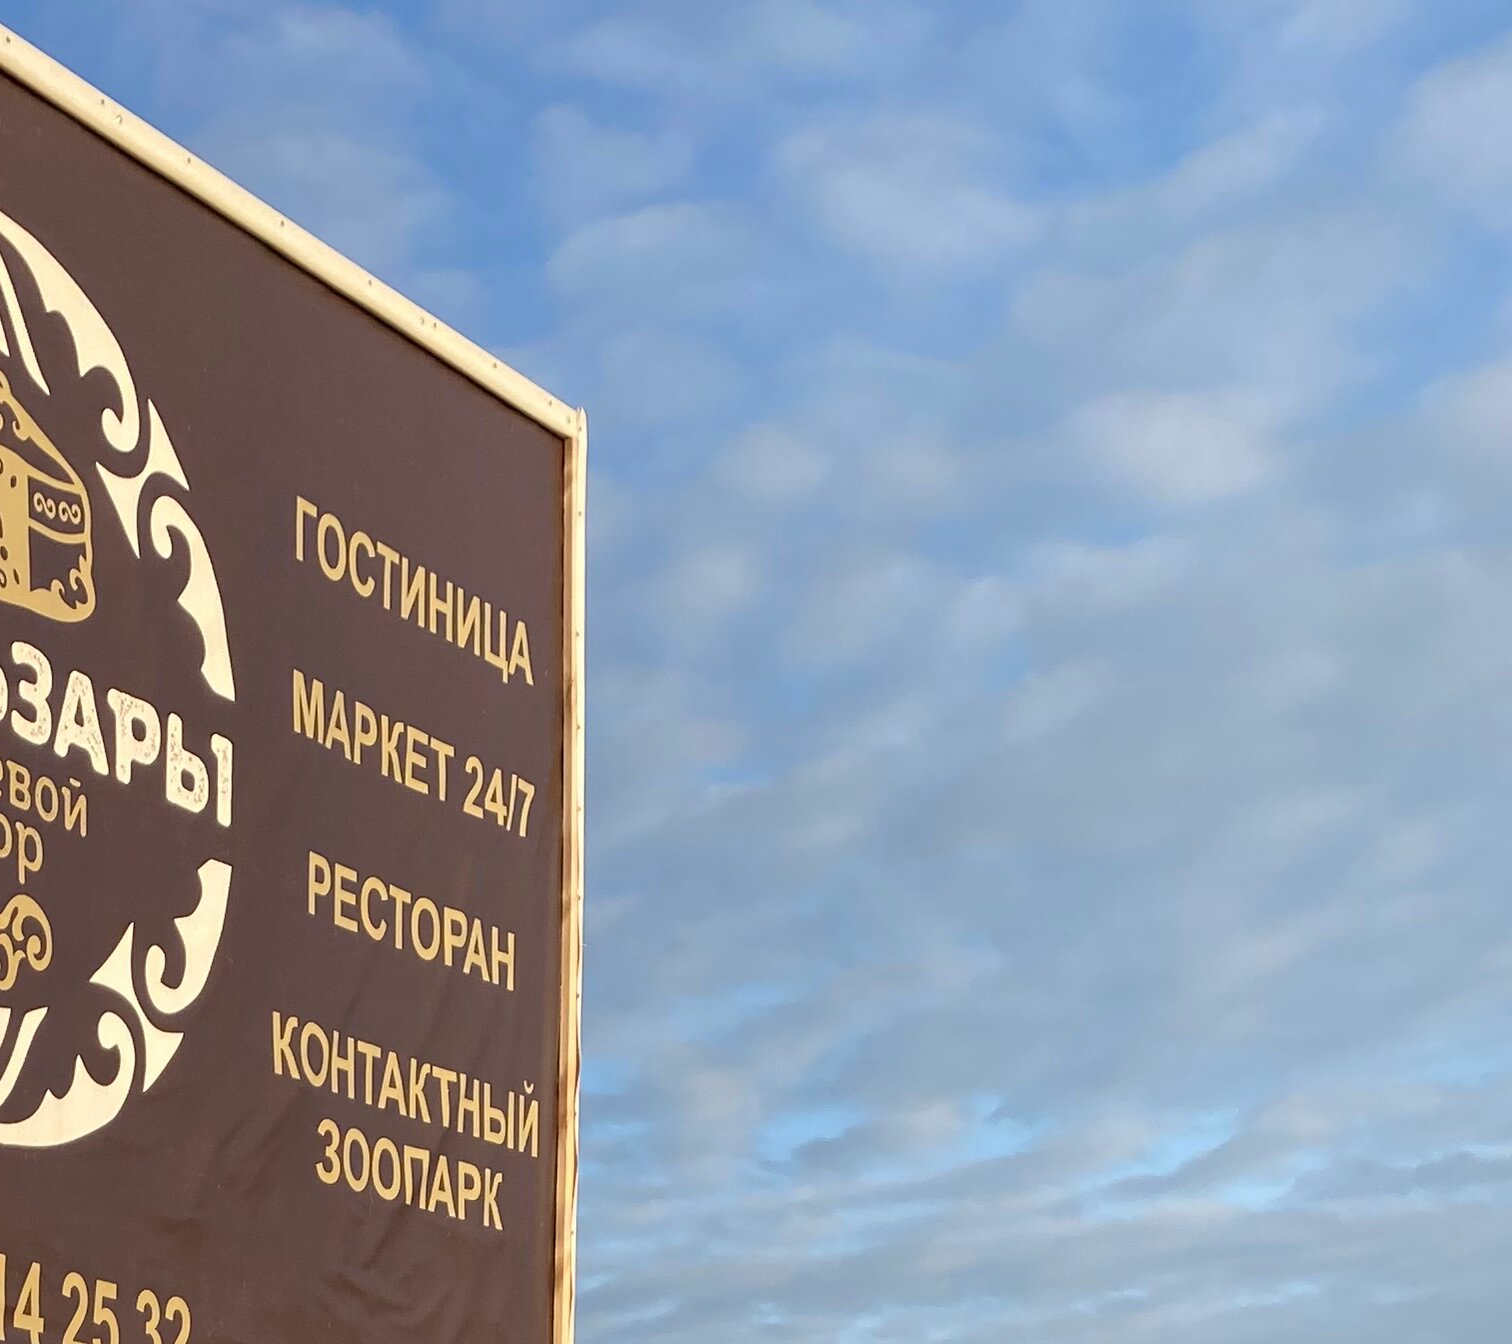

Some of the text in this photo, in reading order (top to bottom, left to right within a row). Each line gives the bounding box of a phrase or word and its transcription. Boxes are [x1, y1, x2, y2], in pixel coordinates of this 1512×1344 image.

[294, 495, 534, 686] ГОСТИНИЦА
[292, 668, 537, 838] МАРКЕТ 24/7
[307, 850, 516, 992] РЕСТОРАН
[271, 1010, 540, 1158] КОНТАКТНЫЙ
[315, 1118, 503, 1231] ЗООПАРК
